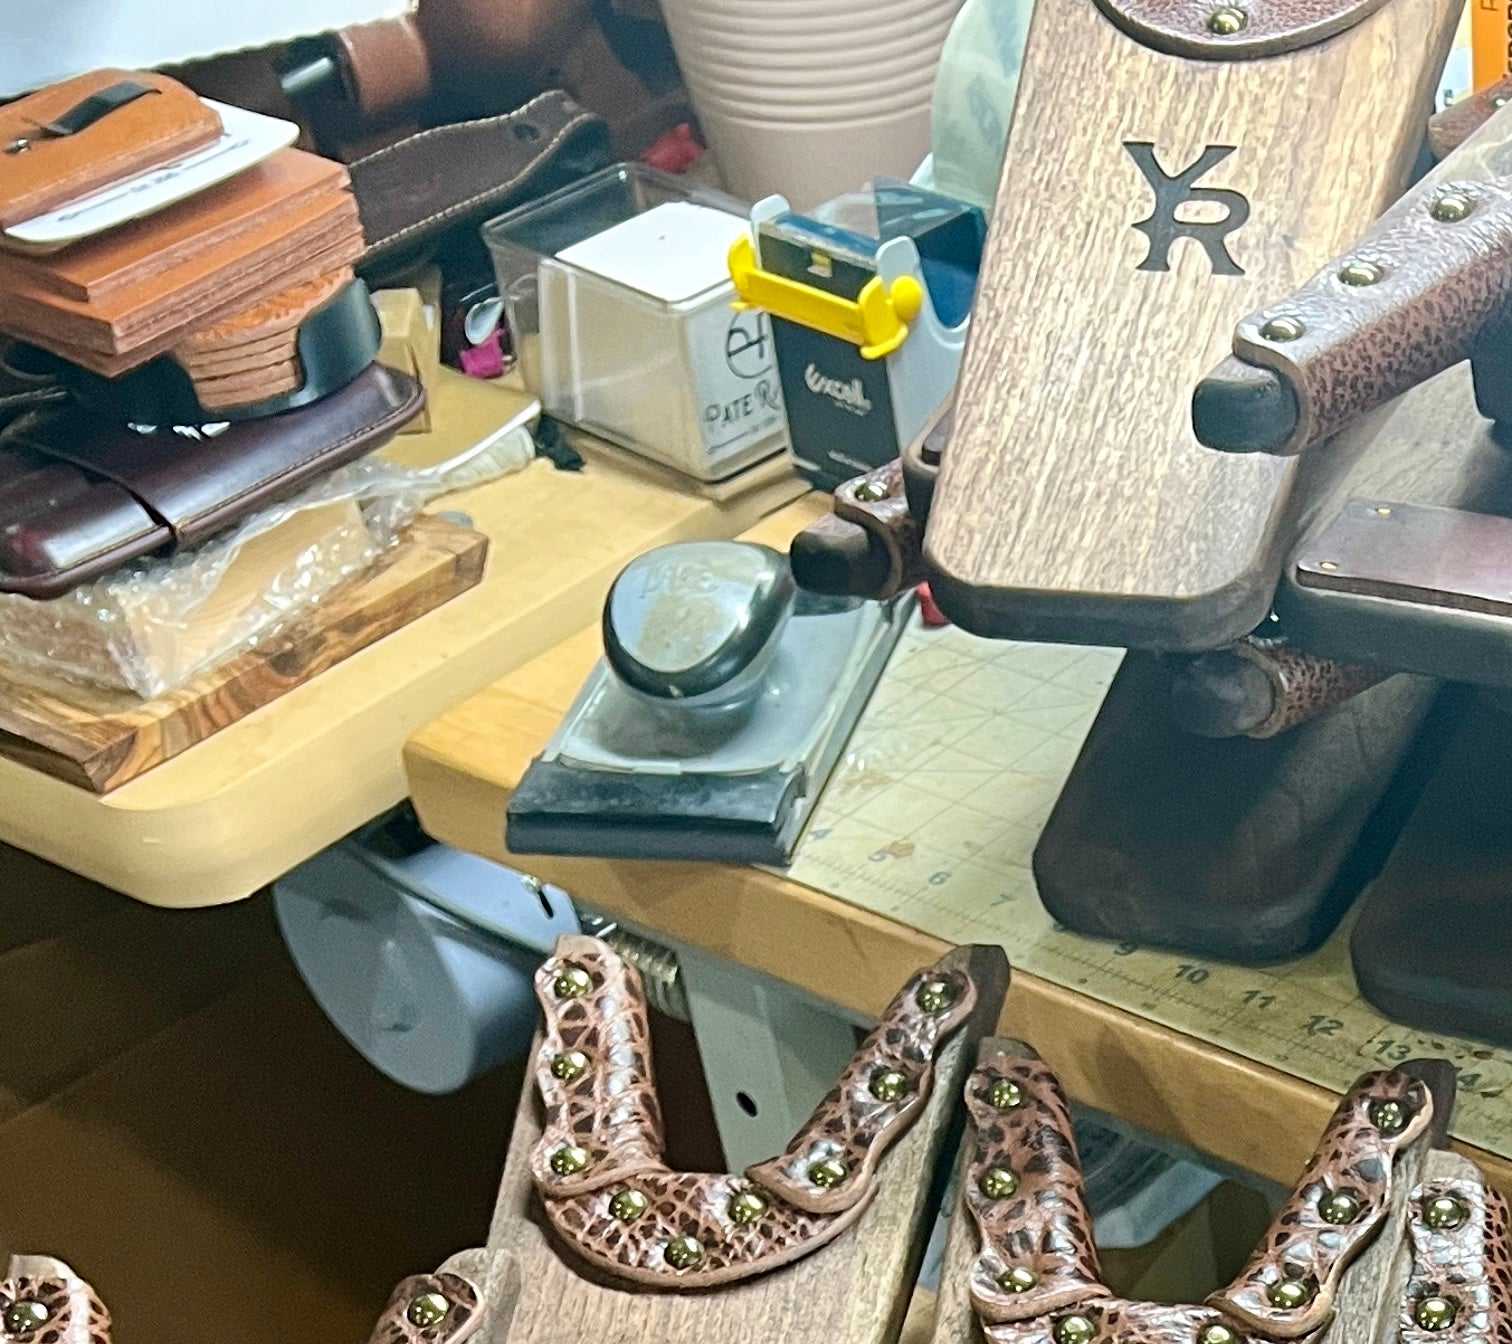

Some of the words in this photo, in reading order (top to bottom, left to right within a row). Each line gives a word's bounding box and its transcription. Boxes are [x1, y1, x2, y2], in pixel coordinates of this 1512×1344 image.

[1124, 141, 1250, 275] YR
[928, 871, 952, 885] 6
[1175, 964, 1209, 985] 10
[1243, 990, 1276, 1009] 11
[1304, 1015, 1343, 1036] 12
[1376, 1038, 1411, 1061] 13
